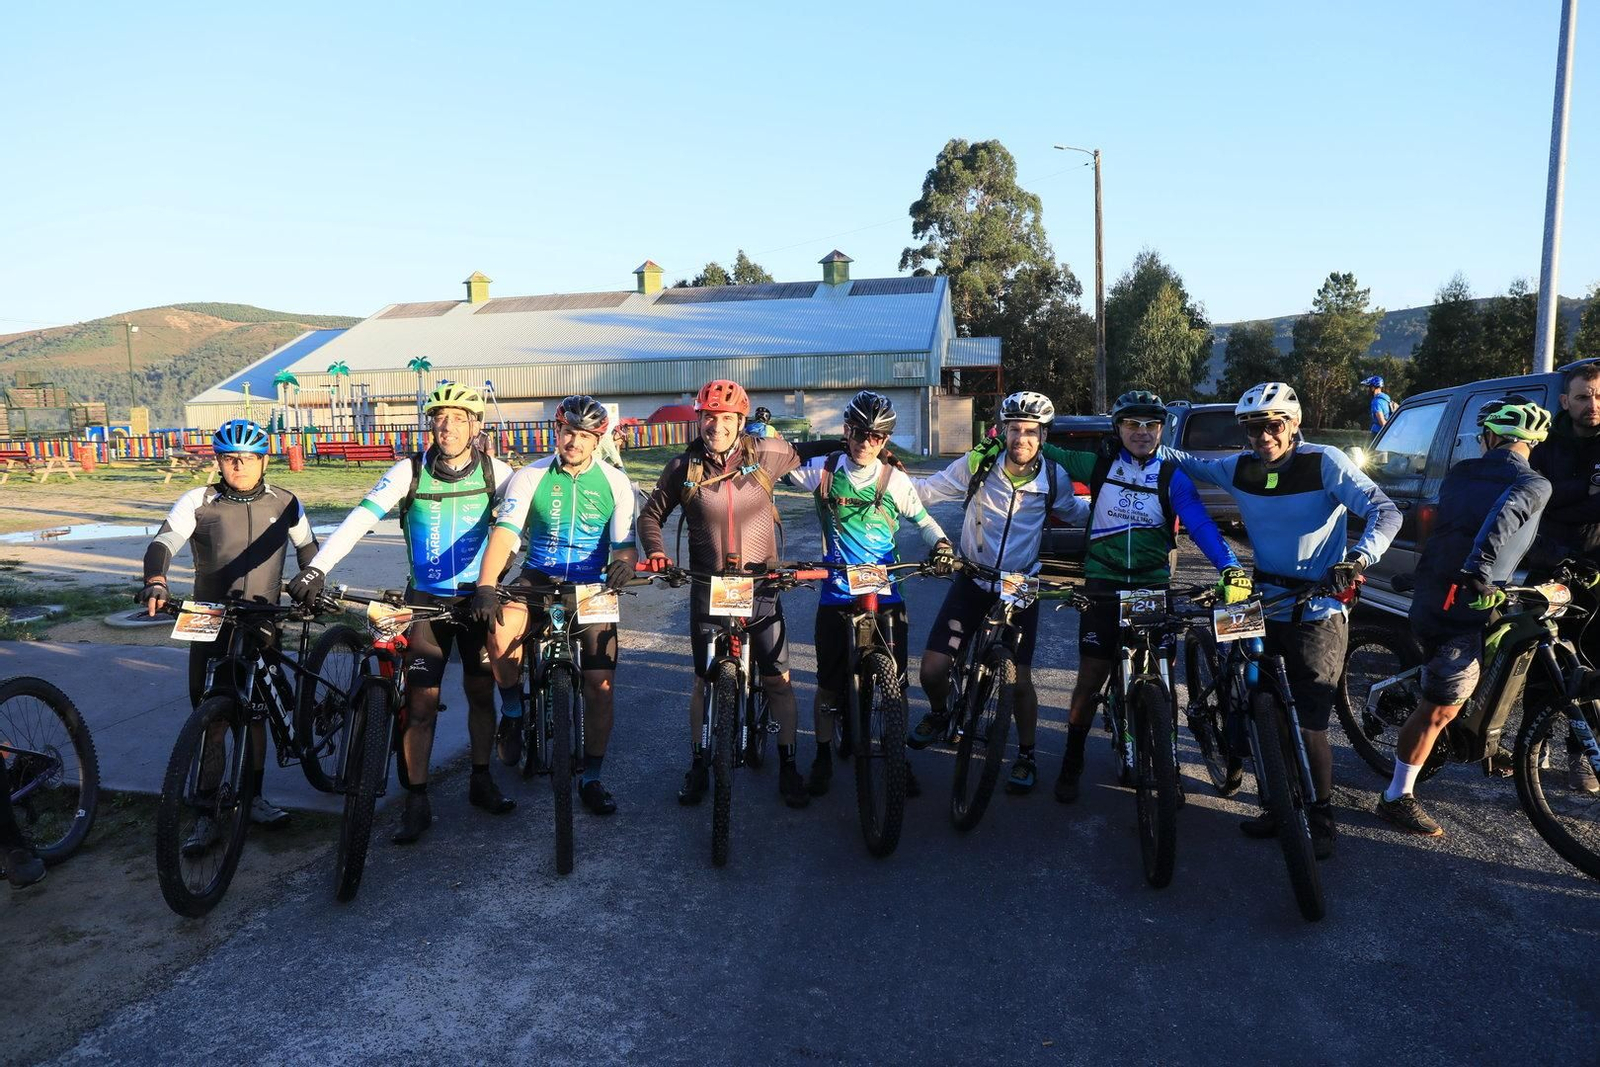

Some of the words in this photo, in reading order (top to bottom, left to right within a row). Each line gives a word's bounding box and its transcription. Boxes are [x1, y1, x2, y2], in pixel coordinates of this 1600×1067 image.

[1126, 508, 1149, 518] Cclista
[300, 569, 319, 586] FOX
[726, 588, 742, 601] 16
[190, 613, 212, 625] 22
[1229, 612, 1246, 624] 17
